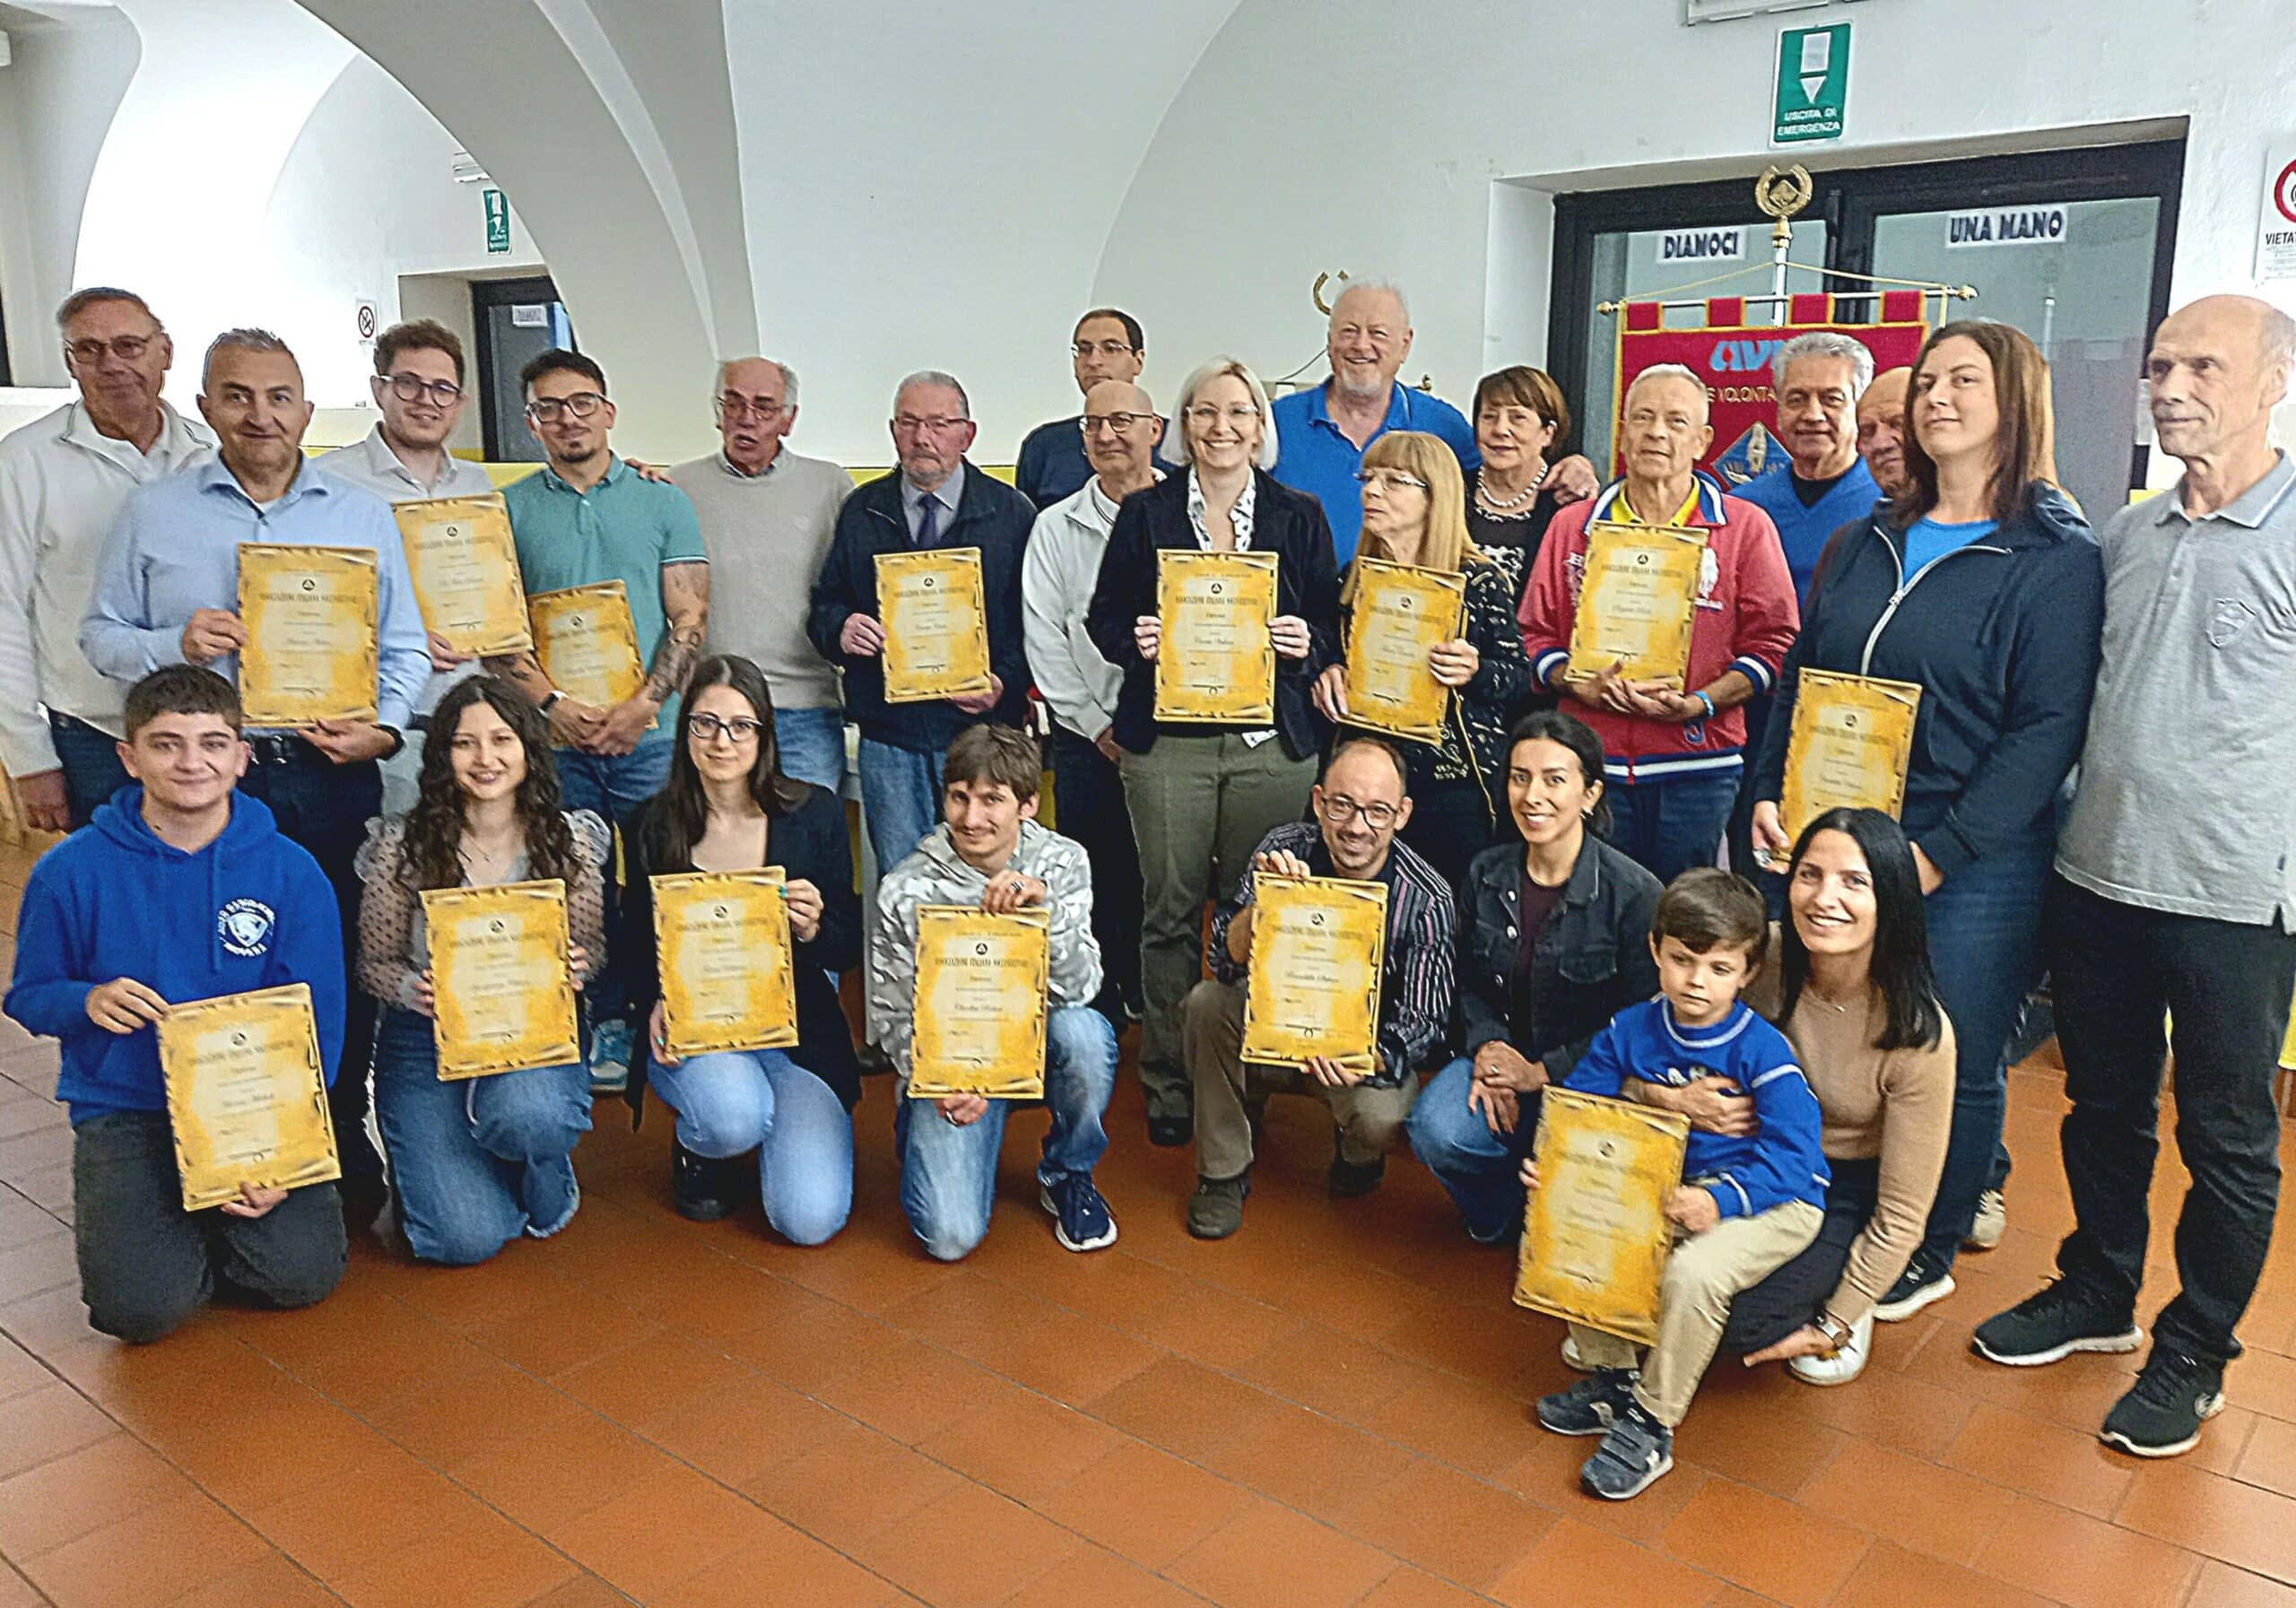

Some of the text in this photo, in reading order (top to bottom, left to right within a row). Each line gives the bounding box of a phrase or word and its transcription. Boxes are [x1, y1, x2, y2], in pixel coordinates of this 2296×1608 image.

[1783, 107, 1838, 122] USCITA DI
[1777, 121, 1840, 136] EMERGENZA
[1950, 210, 2063, 243] UNA MANO
